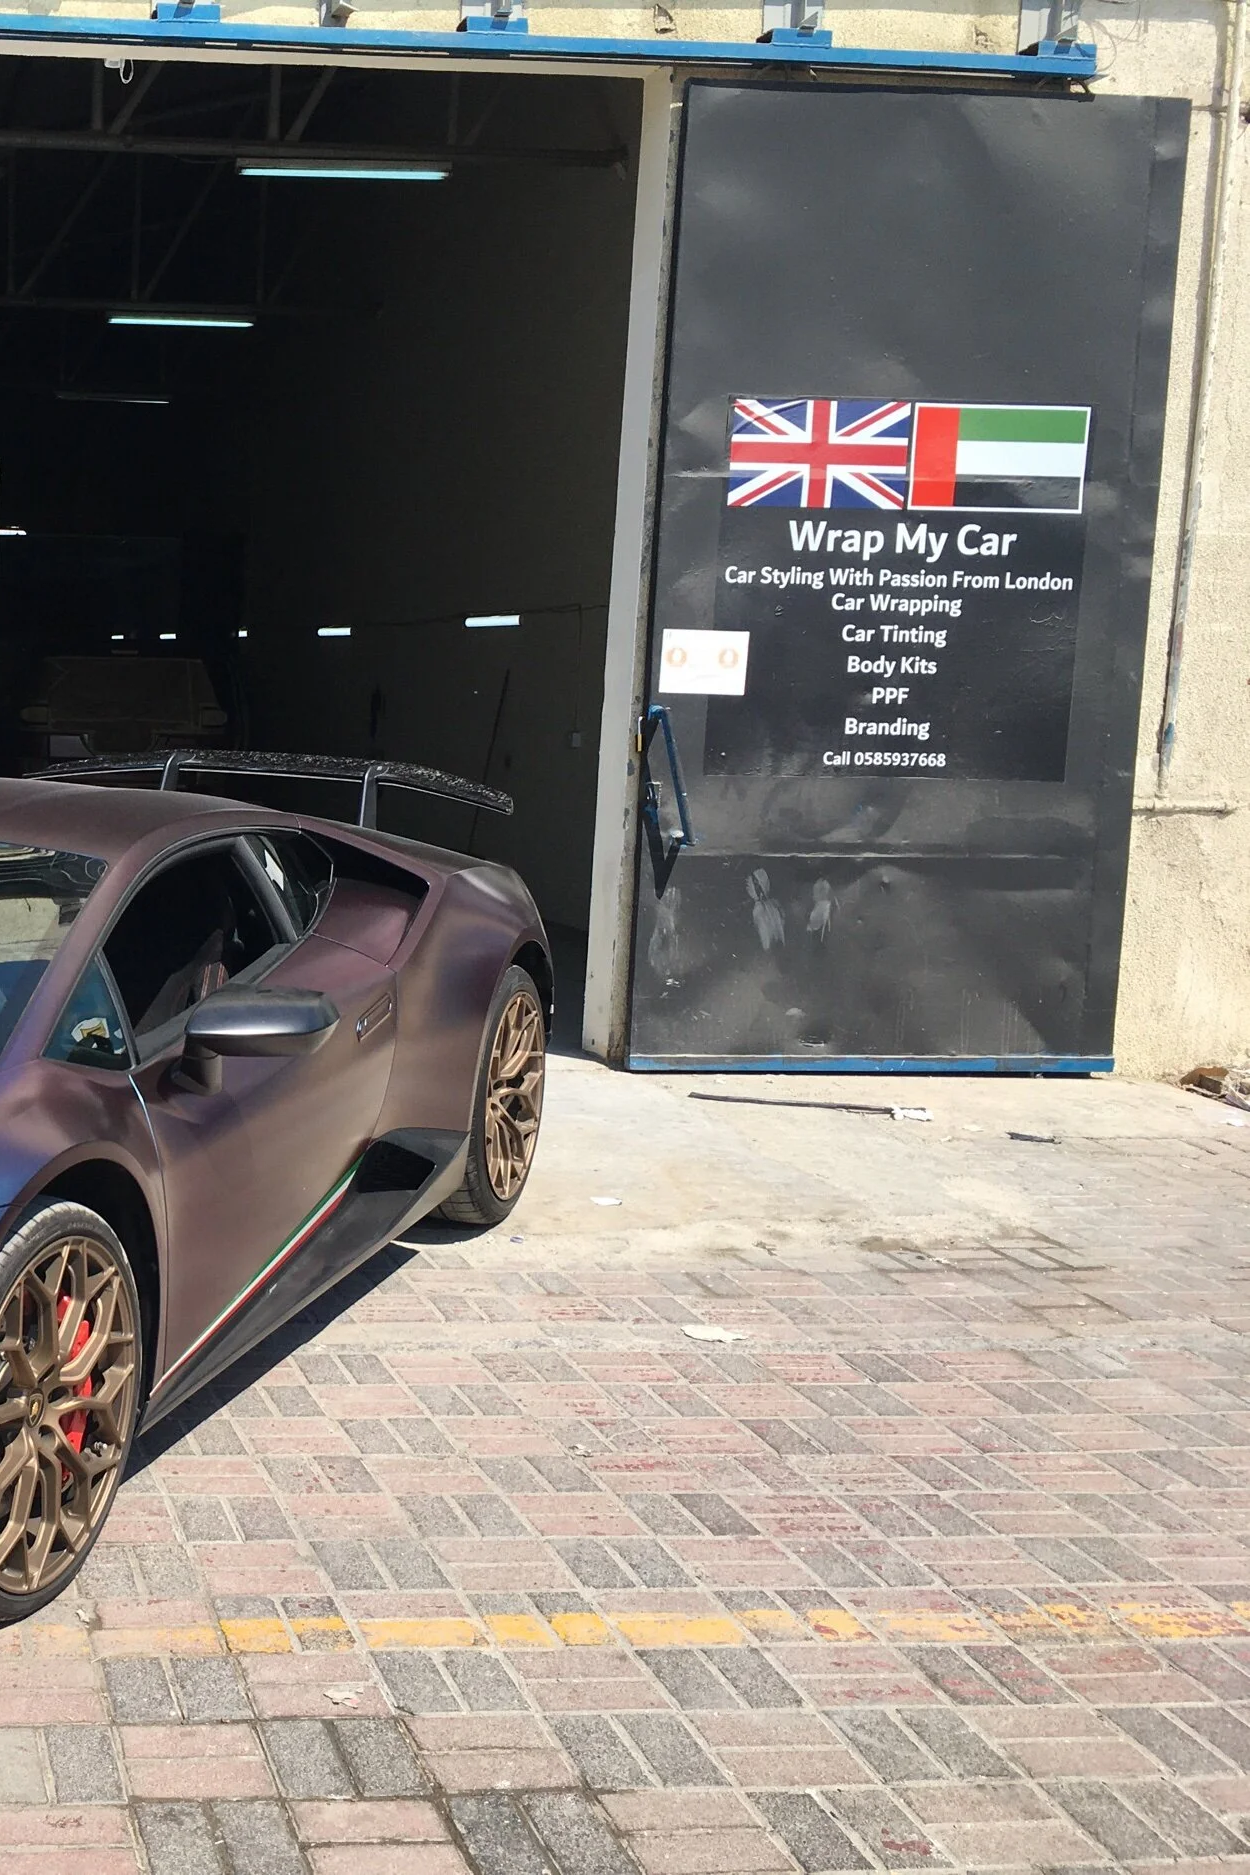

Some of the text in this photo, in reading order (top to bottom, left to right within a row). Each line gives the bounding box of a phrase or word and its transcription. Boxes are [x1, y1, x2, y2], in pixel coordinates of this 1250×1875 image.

[789, 521, 1017, 562] Wrap My Car
[725, 566, 1073, 591] Car Styling With Passion From London
[832, 593, 962, 617] Car Wrapping
[842, 625, 947, 648] Car Tinting
[848, 655, 937, 677] Body Kits
[872, 687, 909, 705] PPF
[845, 718, 930, 740] Branding
[823, 751, 946, 767] Call 0585937668
